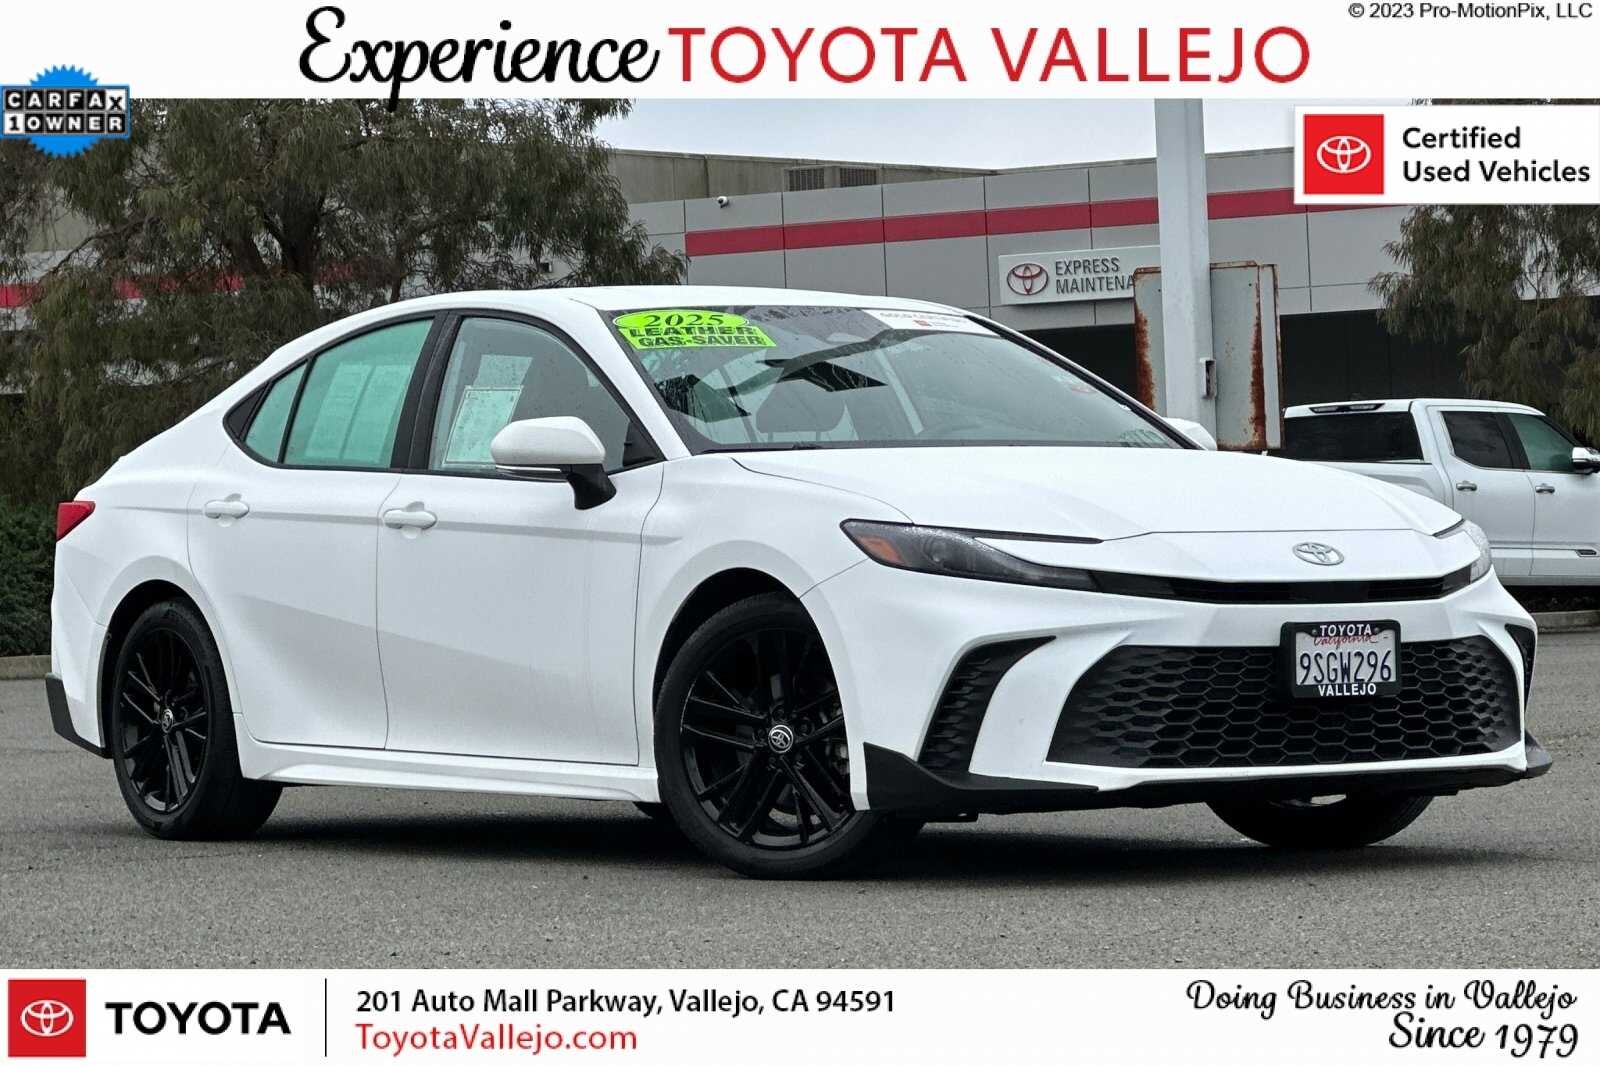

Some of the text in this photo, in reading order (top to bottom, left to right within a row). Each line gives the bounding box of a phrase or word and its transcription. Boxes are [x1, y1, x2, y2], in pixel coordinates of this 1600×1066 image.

[1055, 257, 1120, 276] EXPRESS
[643, 313, 725, 327] 2025
[629, 326, 755, 337] LEATHER
[1320, 624, 1372, 636] TOYOTA
[1299, 650, 1392, 685] 9SGW296
[1318, 683, 1377, 697] VALLEJO
